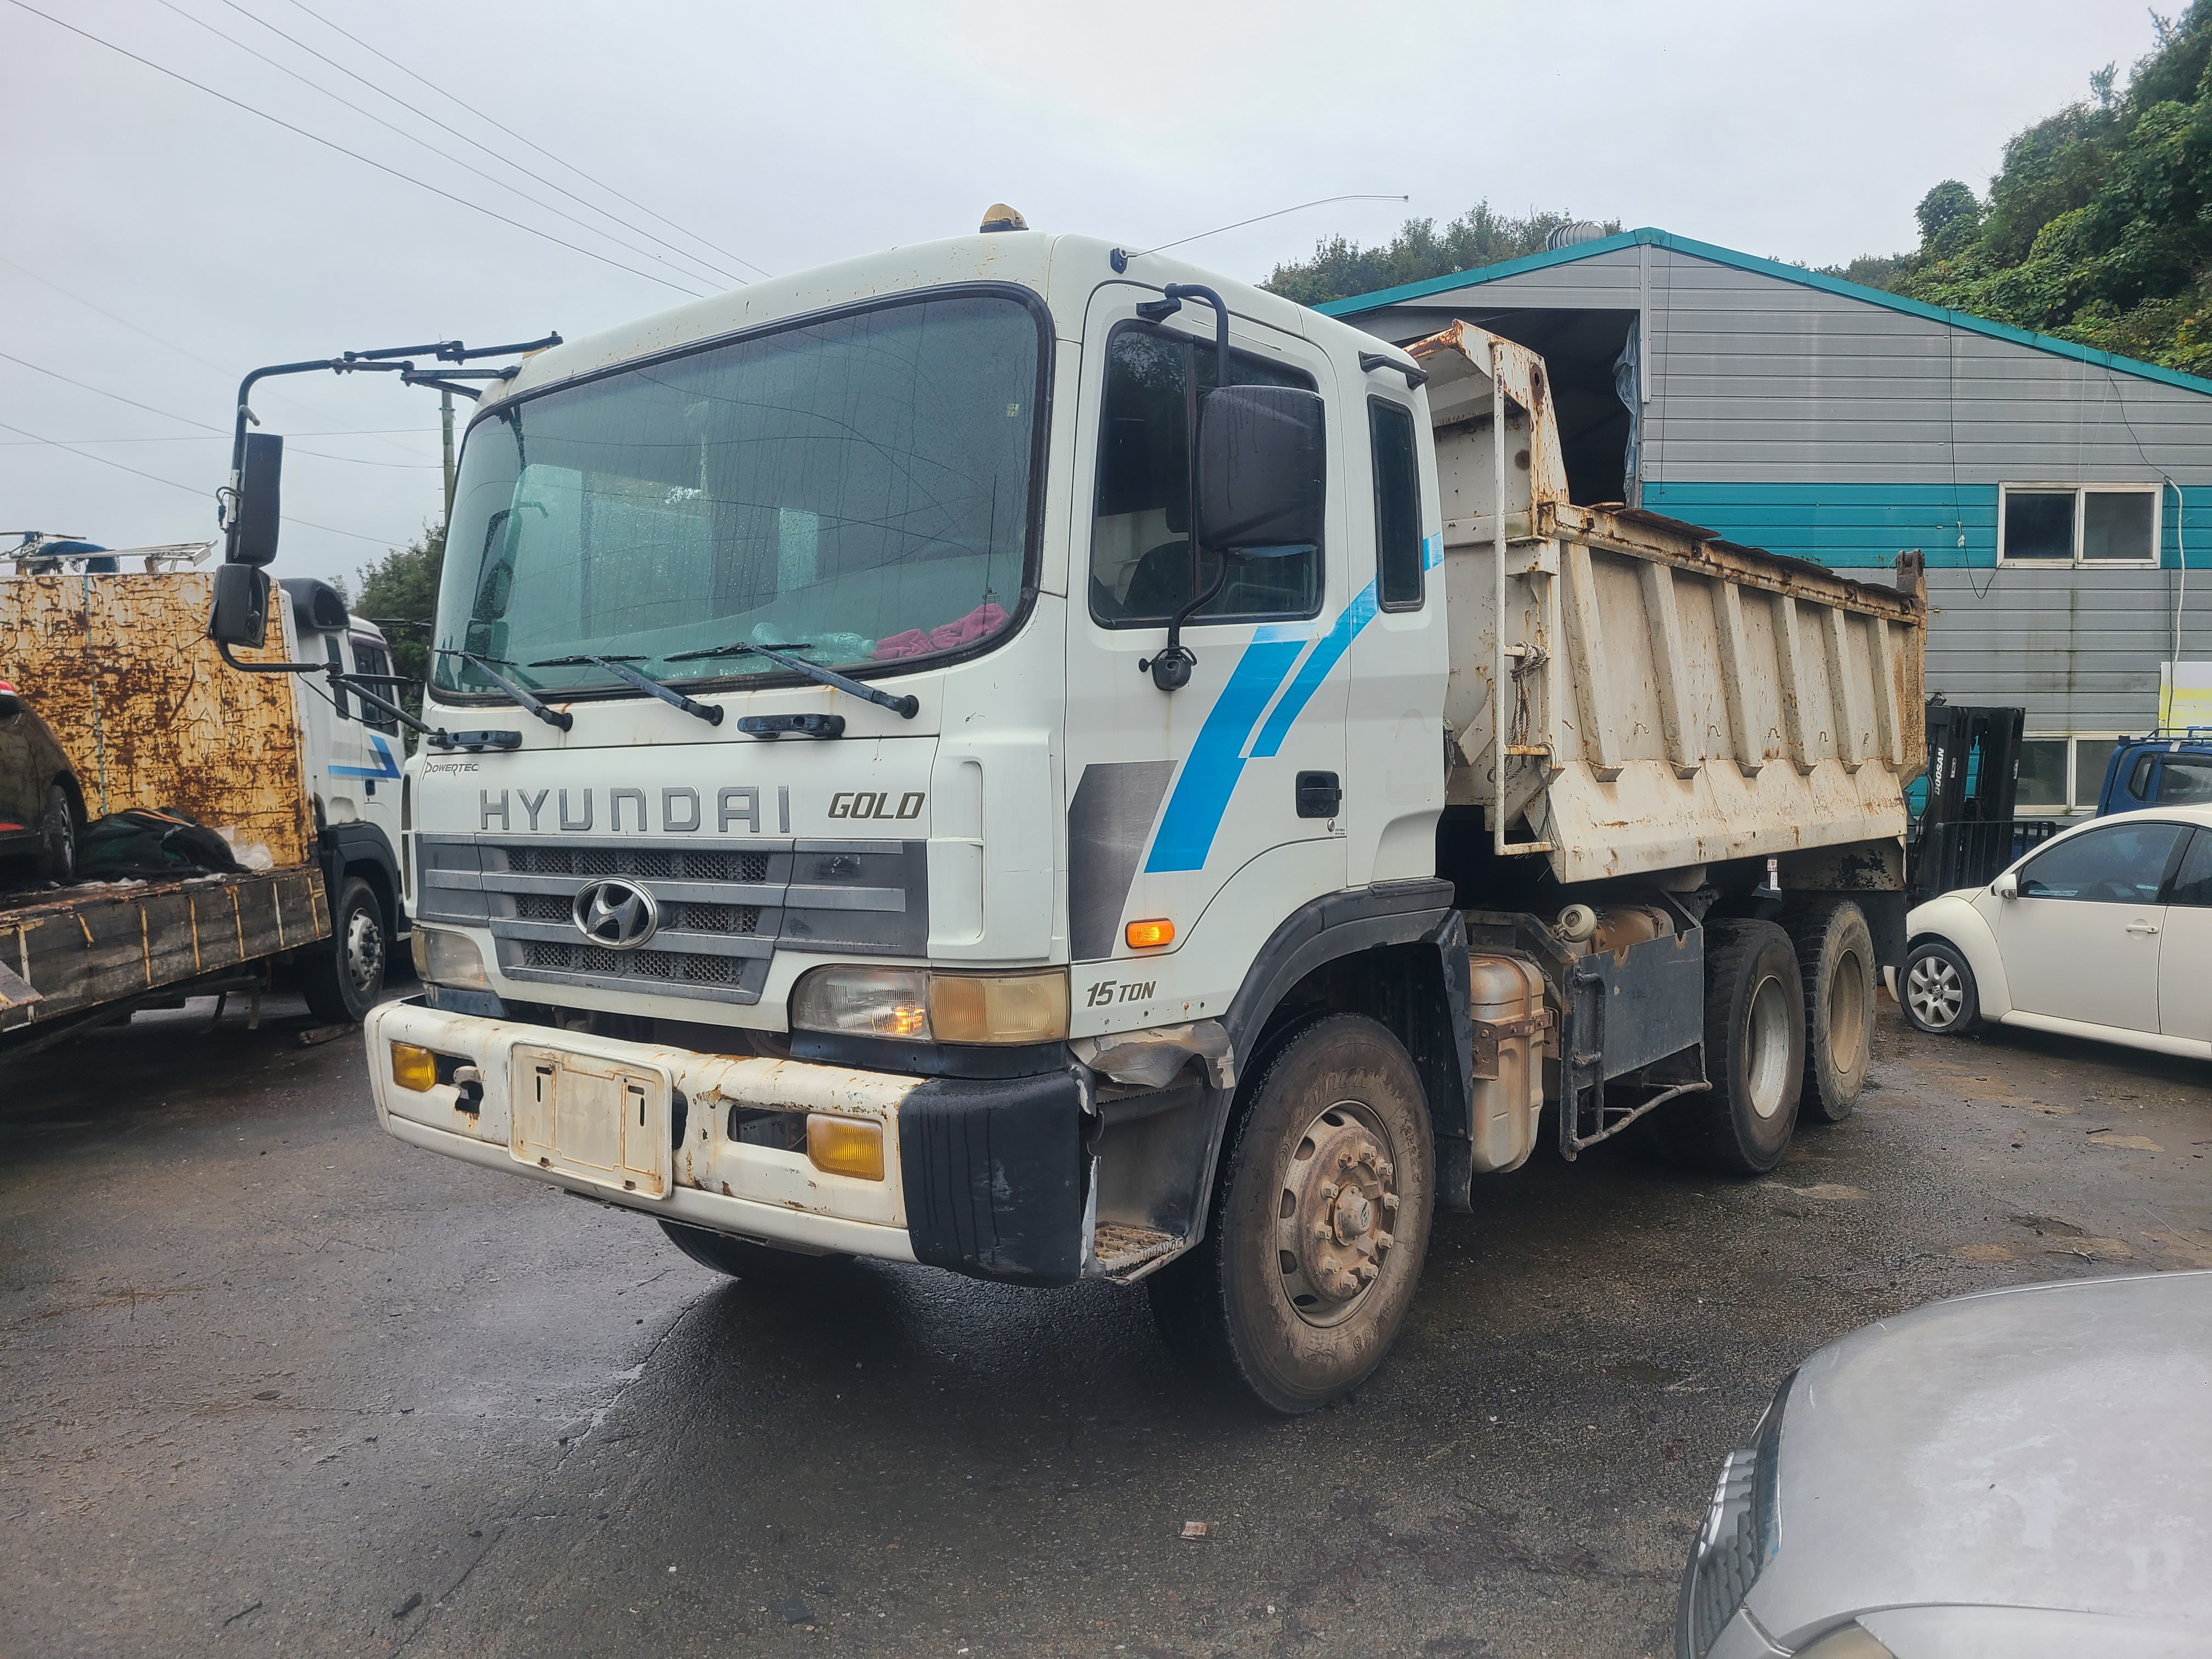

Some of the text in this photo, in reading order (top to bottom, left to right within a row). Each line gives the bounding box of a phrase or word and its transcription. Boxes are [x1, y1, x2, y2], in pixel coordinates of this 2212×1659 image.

[422, 761, 479, 781] POWERTEC
[1934, 747, 1944, 795] DOOSAN
[480, 786, 790, 833] HYUNDAI
[827, 792, 926, 819] GOLD
[1087, 980, 1156, 1007] 15 TON
